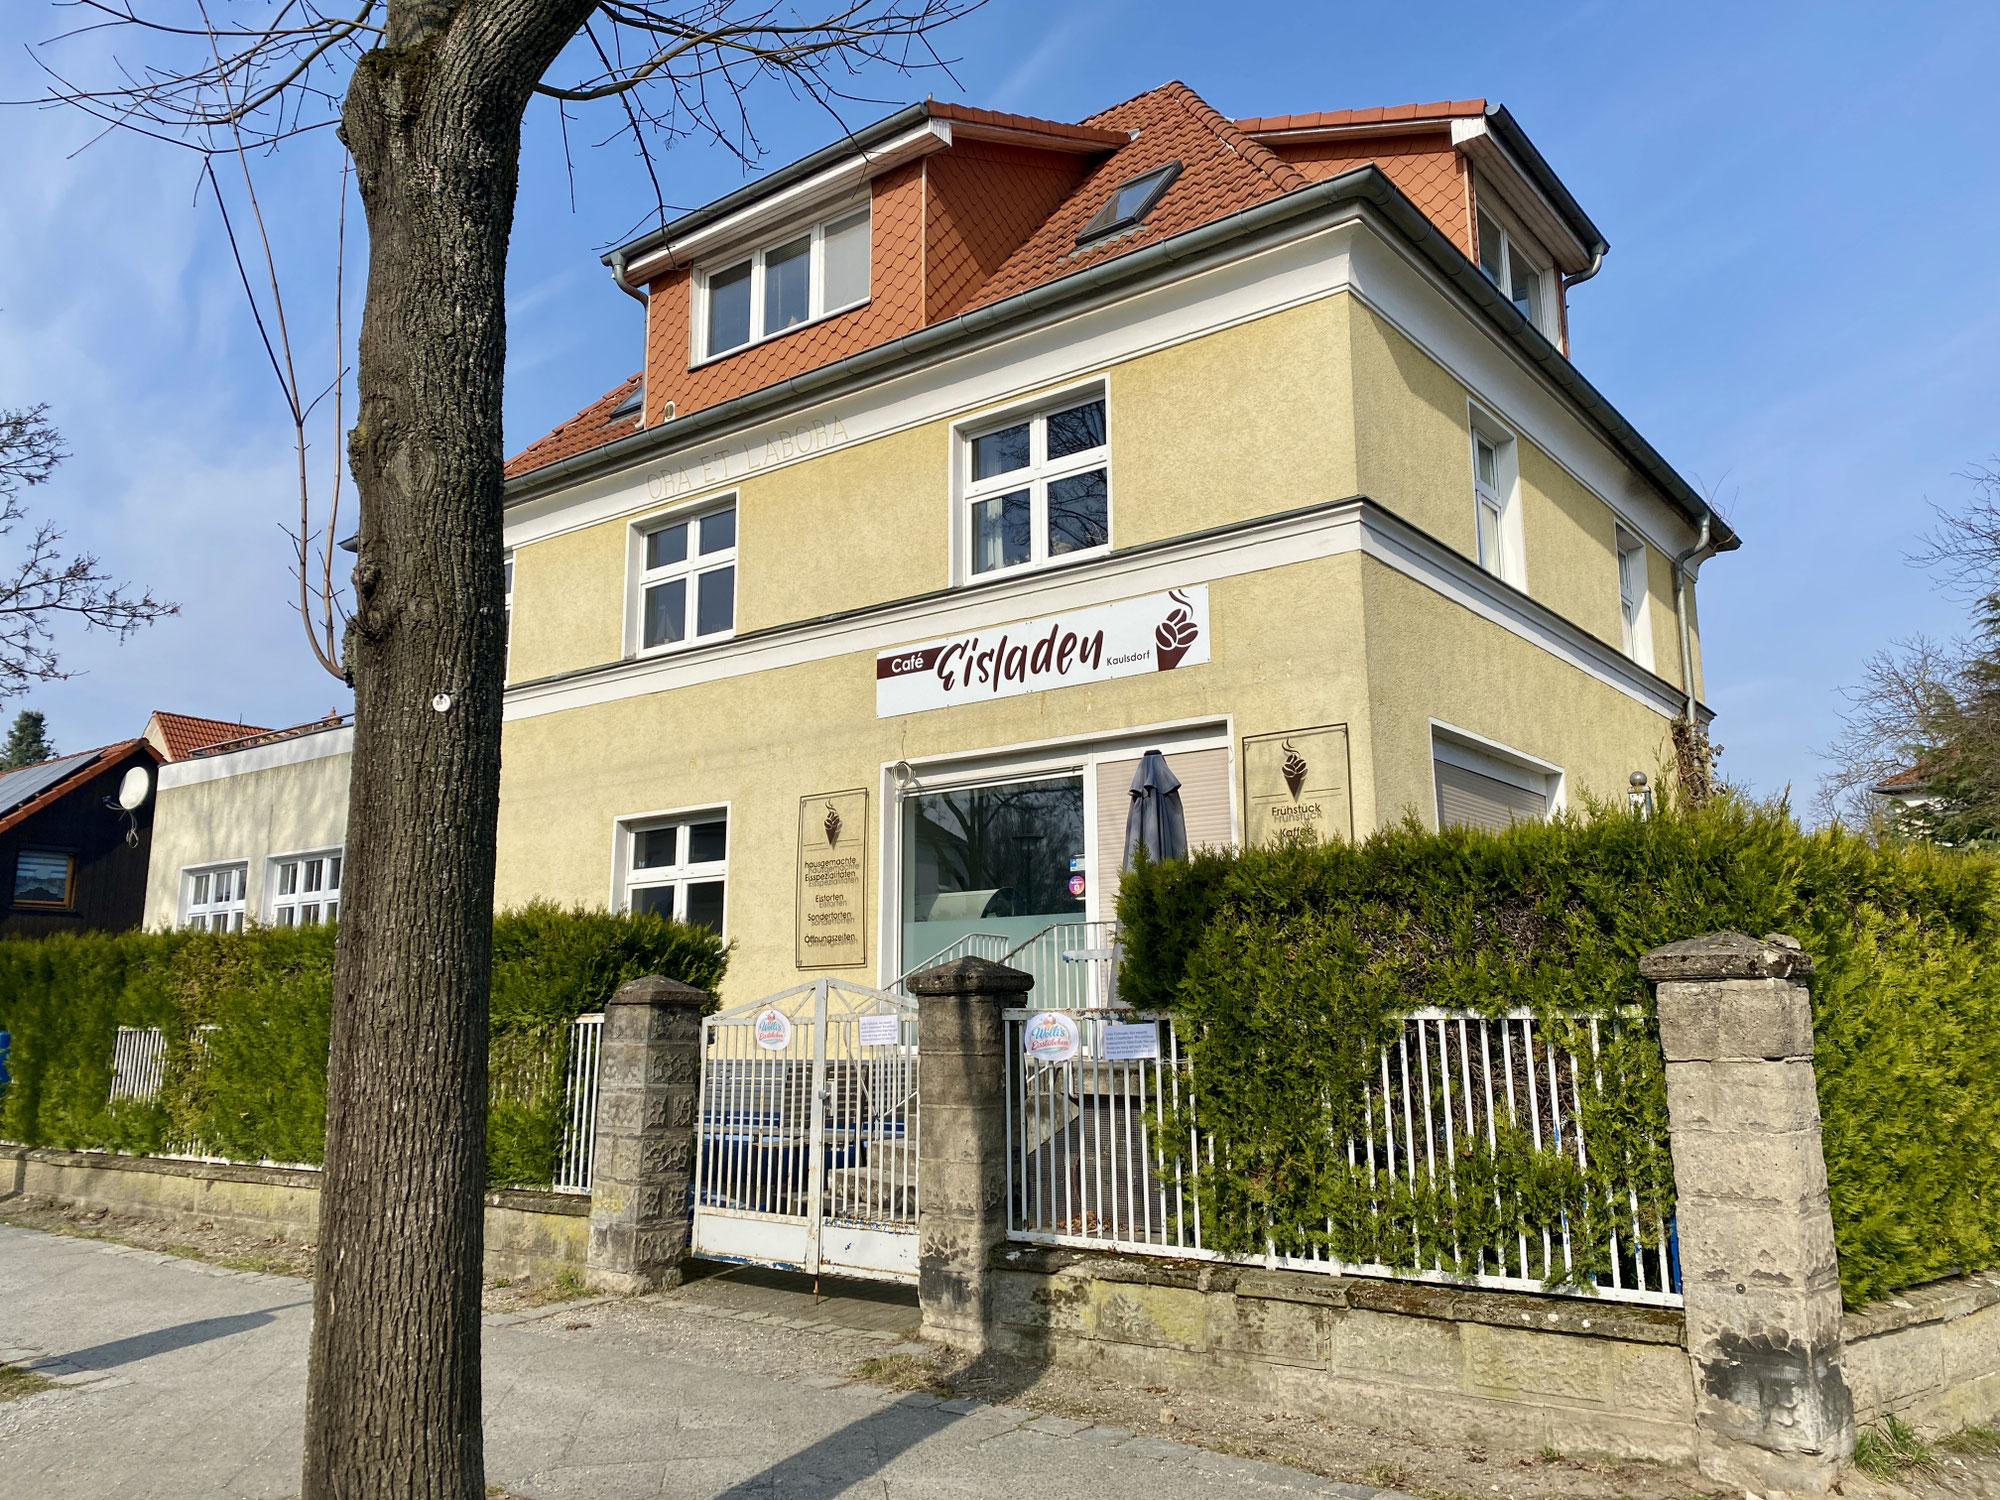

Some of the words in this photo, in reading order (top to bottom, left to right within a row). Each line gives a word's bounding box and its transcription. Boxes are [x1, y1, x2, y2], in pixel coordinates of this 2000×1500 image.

[647, 466, 691, 498] ORA
[699, 449, 730, 484] ET
[743, 415, 849, 470] LABORA
[891, 650, 924, 673] Café
[936, 623, 1104, 692] Eisladen
[1106, 649, 1151, 667] Kaulsdorf
[1271, 802, 1321, 816] Frühstück
[805, 857, 856, 868] hausgemachte
[816, 894, 843, 902] Eistorten
[808, 911, 851, 921] Sondertorten
[1031, 1025, 1065, 1039] Wolli's
